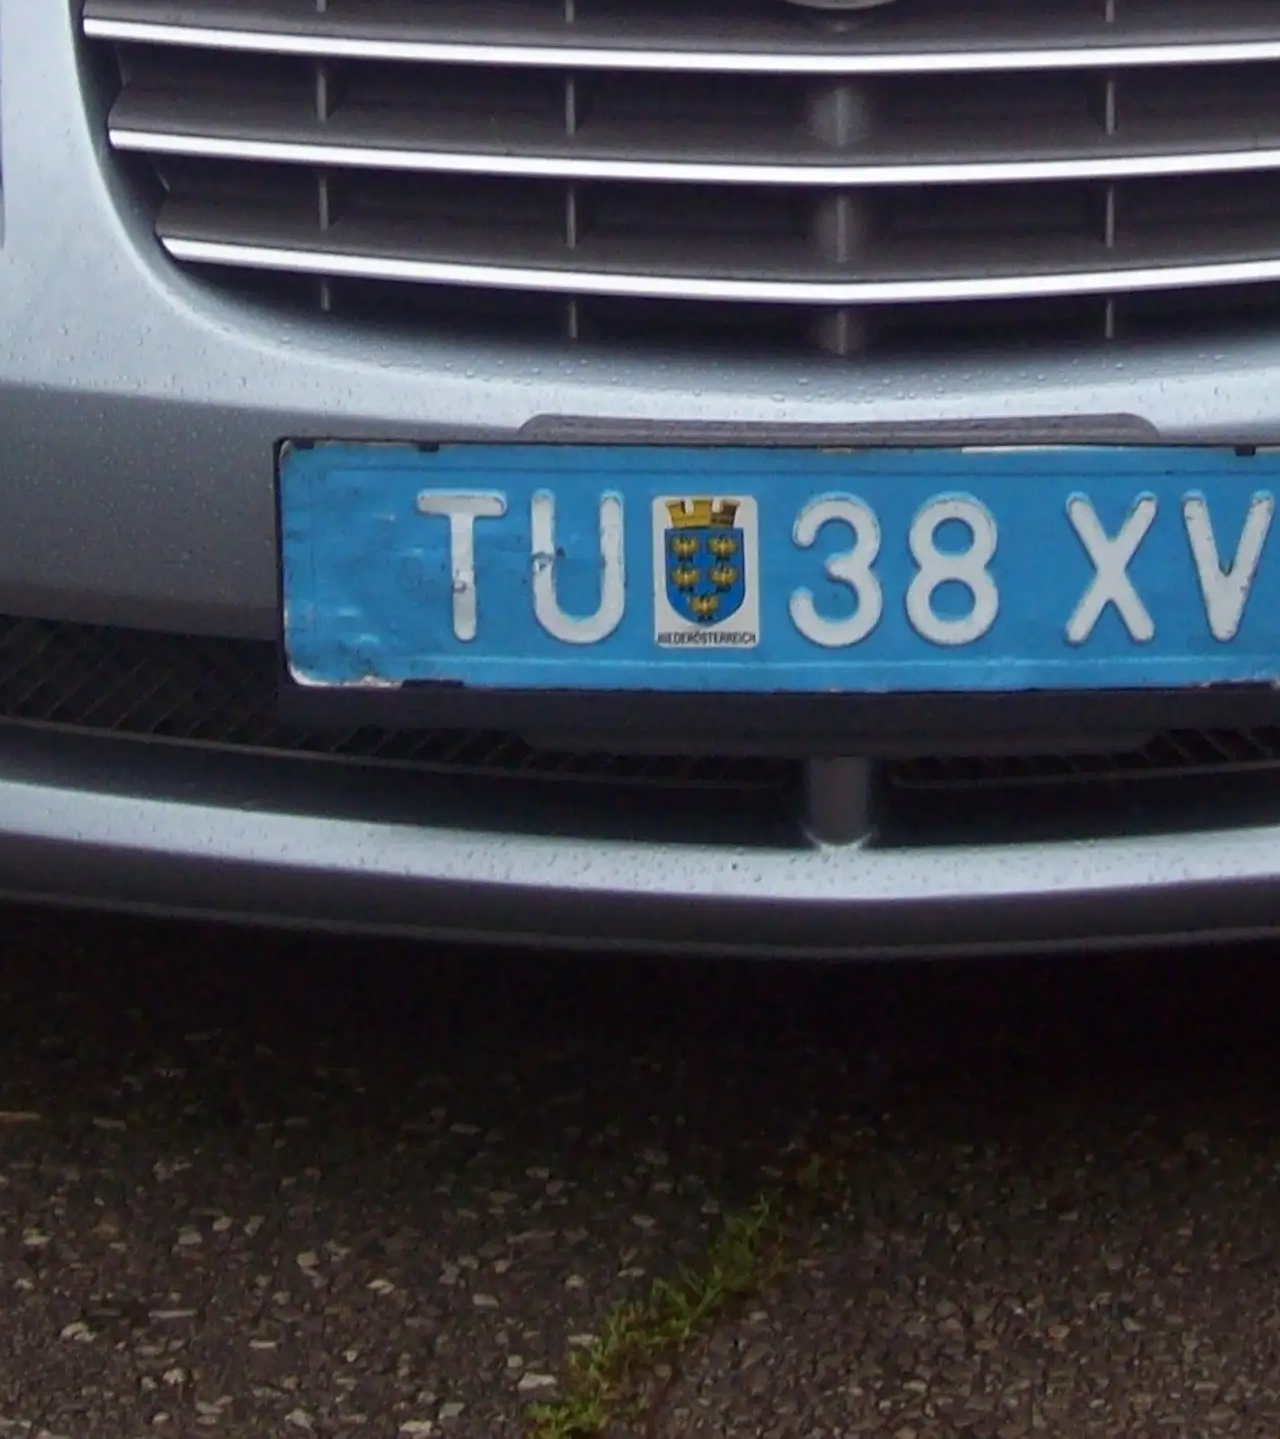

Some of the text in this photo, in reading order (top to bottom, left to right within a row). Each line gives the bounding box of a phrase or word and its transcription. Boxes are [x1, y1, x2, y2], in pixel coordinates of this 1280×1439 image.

[417, 489, 1274, 648] TU 38 XV
